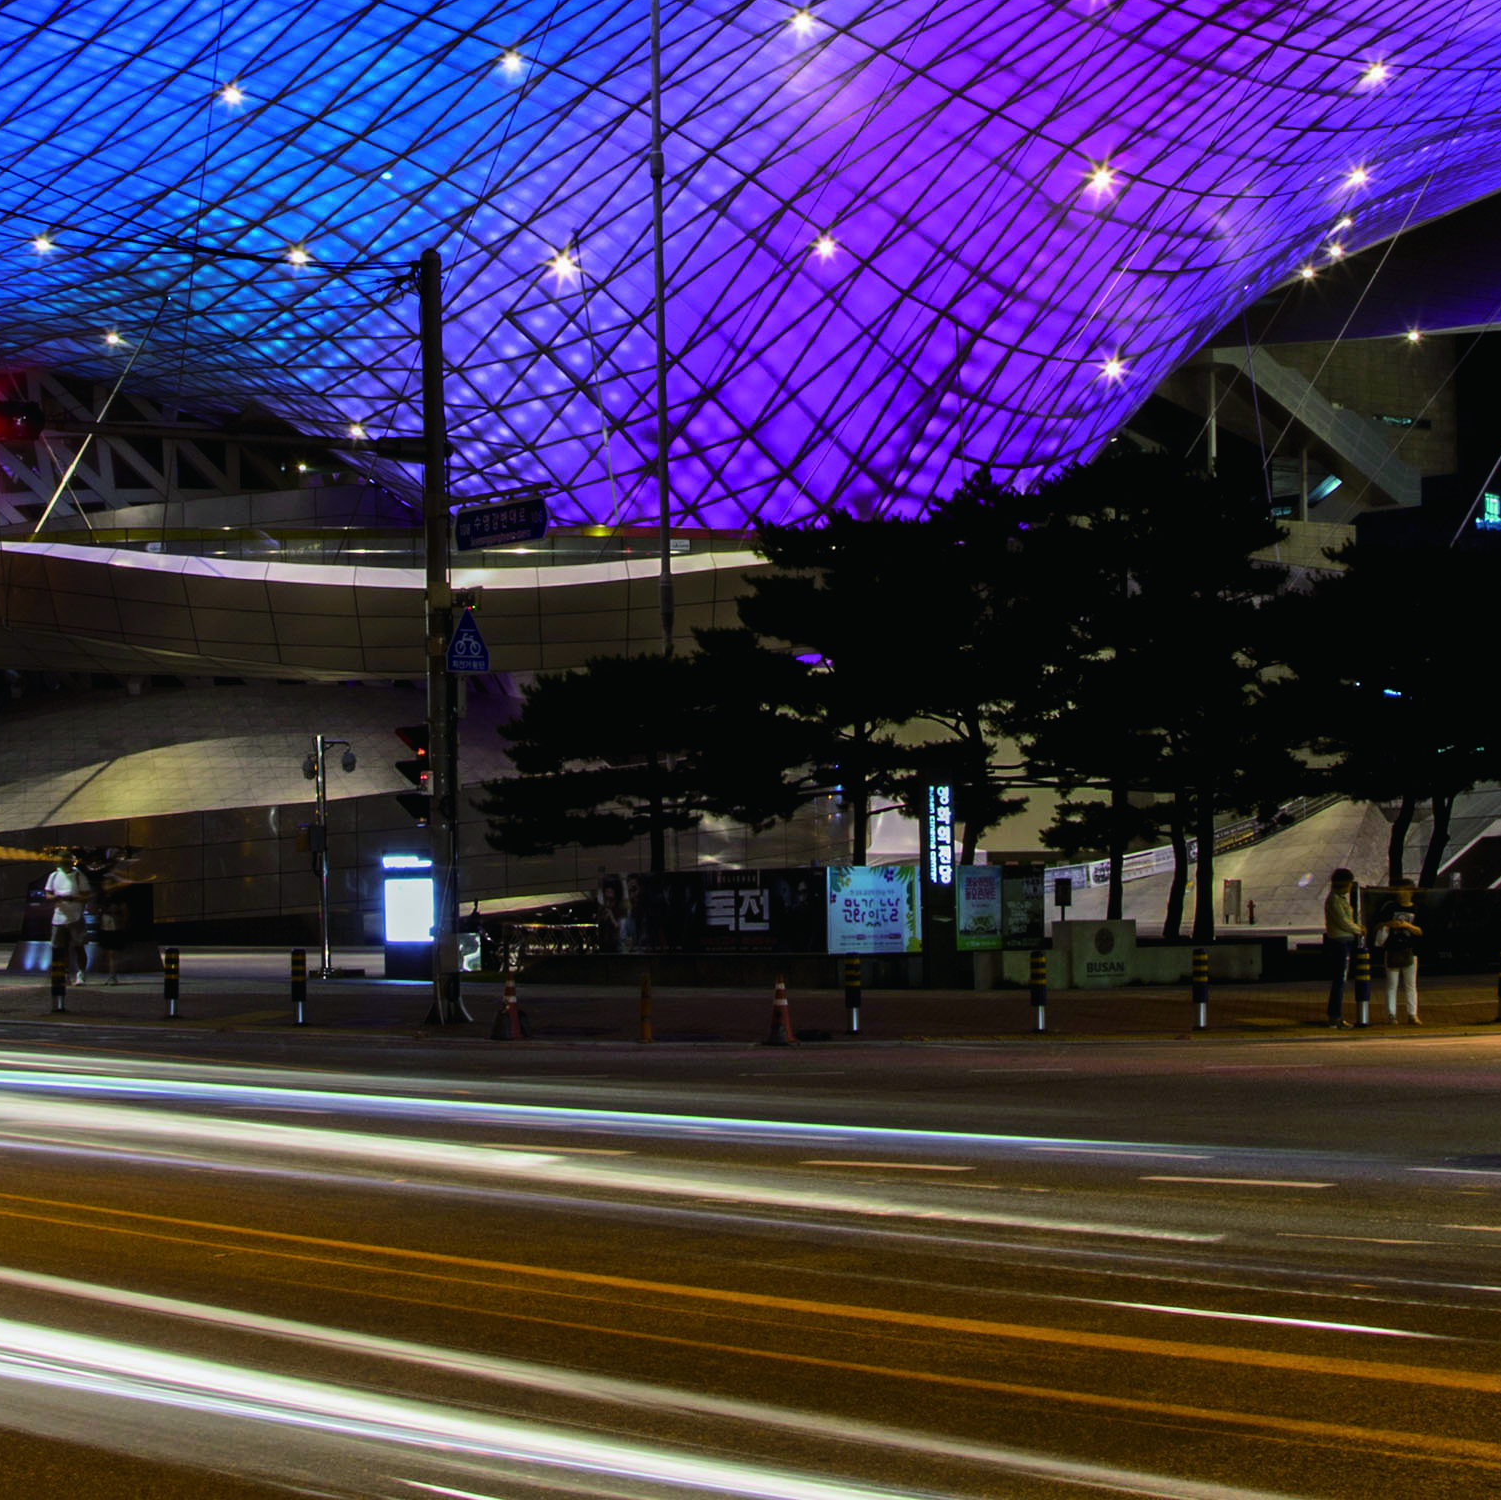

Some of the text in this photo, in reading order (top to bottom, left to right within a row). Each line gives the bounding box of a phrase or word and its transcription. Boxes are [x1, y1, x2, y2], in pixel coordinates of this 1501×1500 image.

[936, 785, 953, 885] 영화의전당
[704, 888, 770, 932] 독전
[1086, 961, 1125, 973] BUSAN
